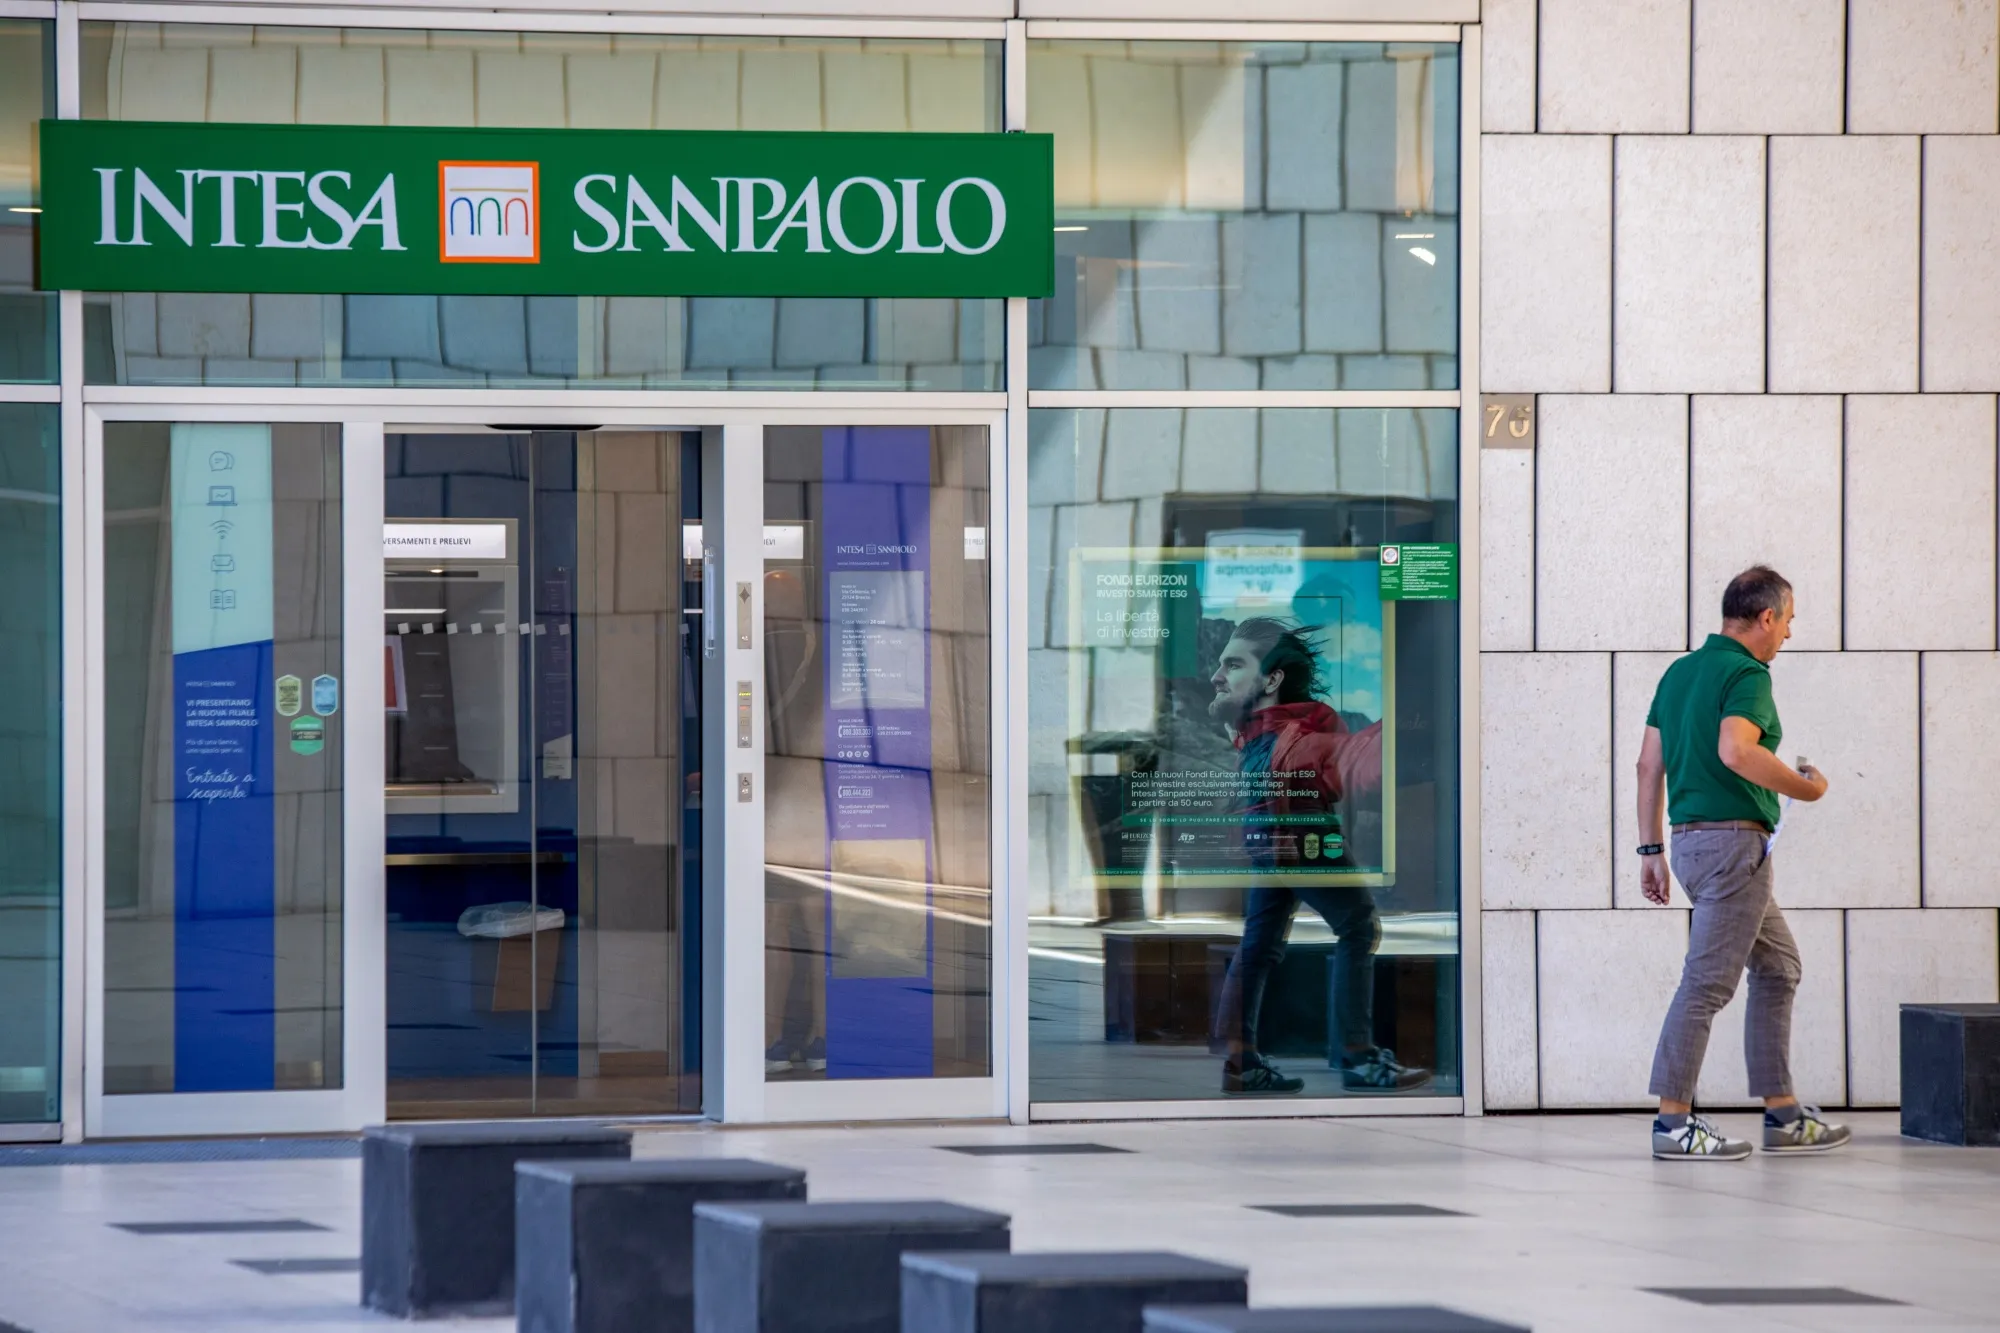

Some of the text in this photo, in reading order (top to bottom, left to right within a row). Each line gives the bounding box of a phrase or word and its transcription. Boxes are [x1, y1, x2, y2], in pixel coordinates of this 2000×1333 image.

[93, 167, 1007, 255] INTESA SANPAOLO
[1486, 405, 1531, 438] 76
[382, 537, 471, 545] VERSAMENTI E PRELIEVI
[836, 545, 917, 554] INTESA SANPAOLO
[1096, 574, 1188, 586] FONDI EURIZON
[1096, 589, 1188, 598] INVESTO SMART ESG
[1097, 609, 1160, 622] La libertà
[1096, 626, 1170, 638] di investire
[186, 766, 240, 784] Entrate
[1131, 770, 1148, 778] Con
[1154, 770, 1160, 778] 5
[1161, 770, 1184, 778] nuovi
[1185, 770, 1208, 778] Fondi
[1210, 770, 1240, 778] Eurizon
[1241, 770, 1271, 778] Investo
[1272, 770, 1297, 778] Smart
[1131, 780, 1284, 789] puoi investire esclusivamente dall'app
[186, 784, 249, 805] scoprirla
[1131, 790, 1156, 798] Intesa
[1158, 790, 1196, 799] Sanpaolo
[1198, 790, 1227, 798] Investo
[1236, 789, 1284, 798] dall'Internet
[1286, 789, 1319, 798] Banking
[1138, 800, 1166, 808] partire
[1178, 833, 1196, 842] ATP
